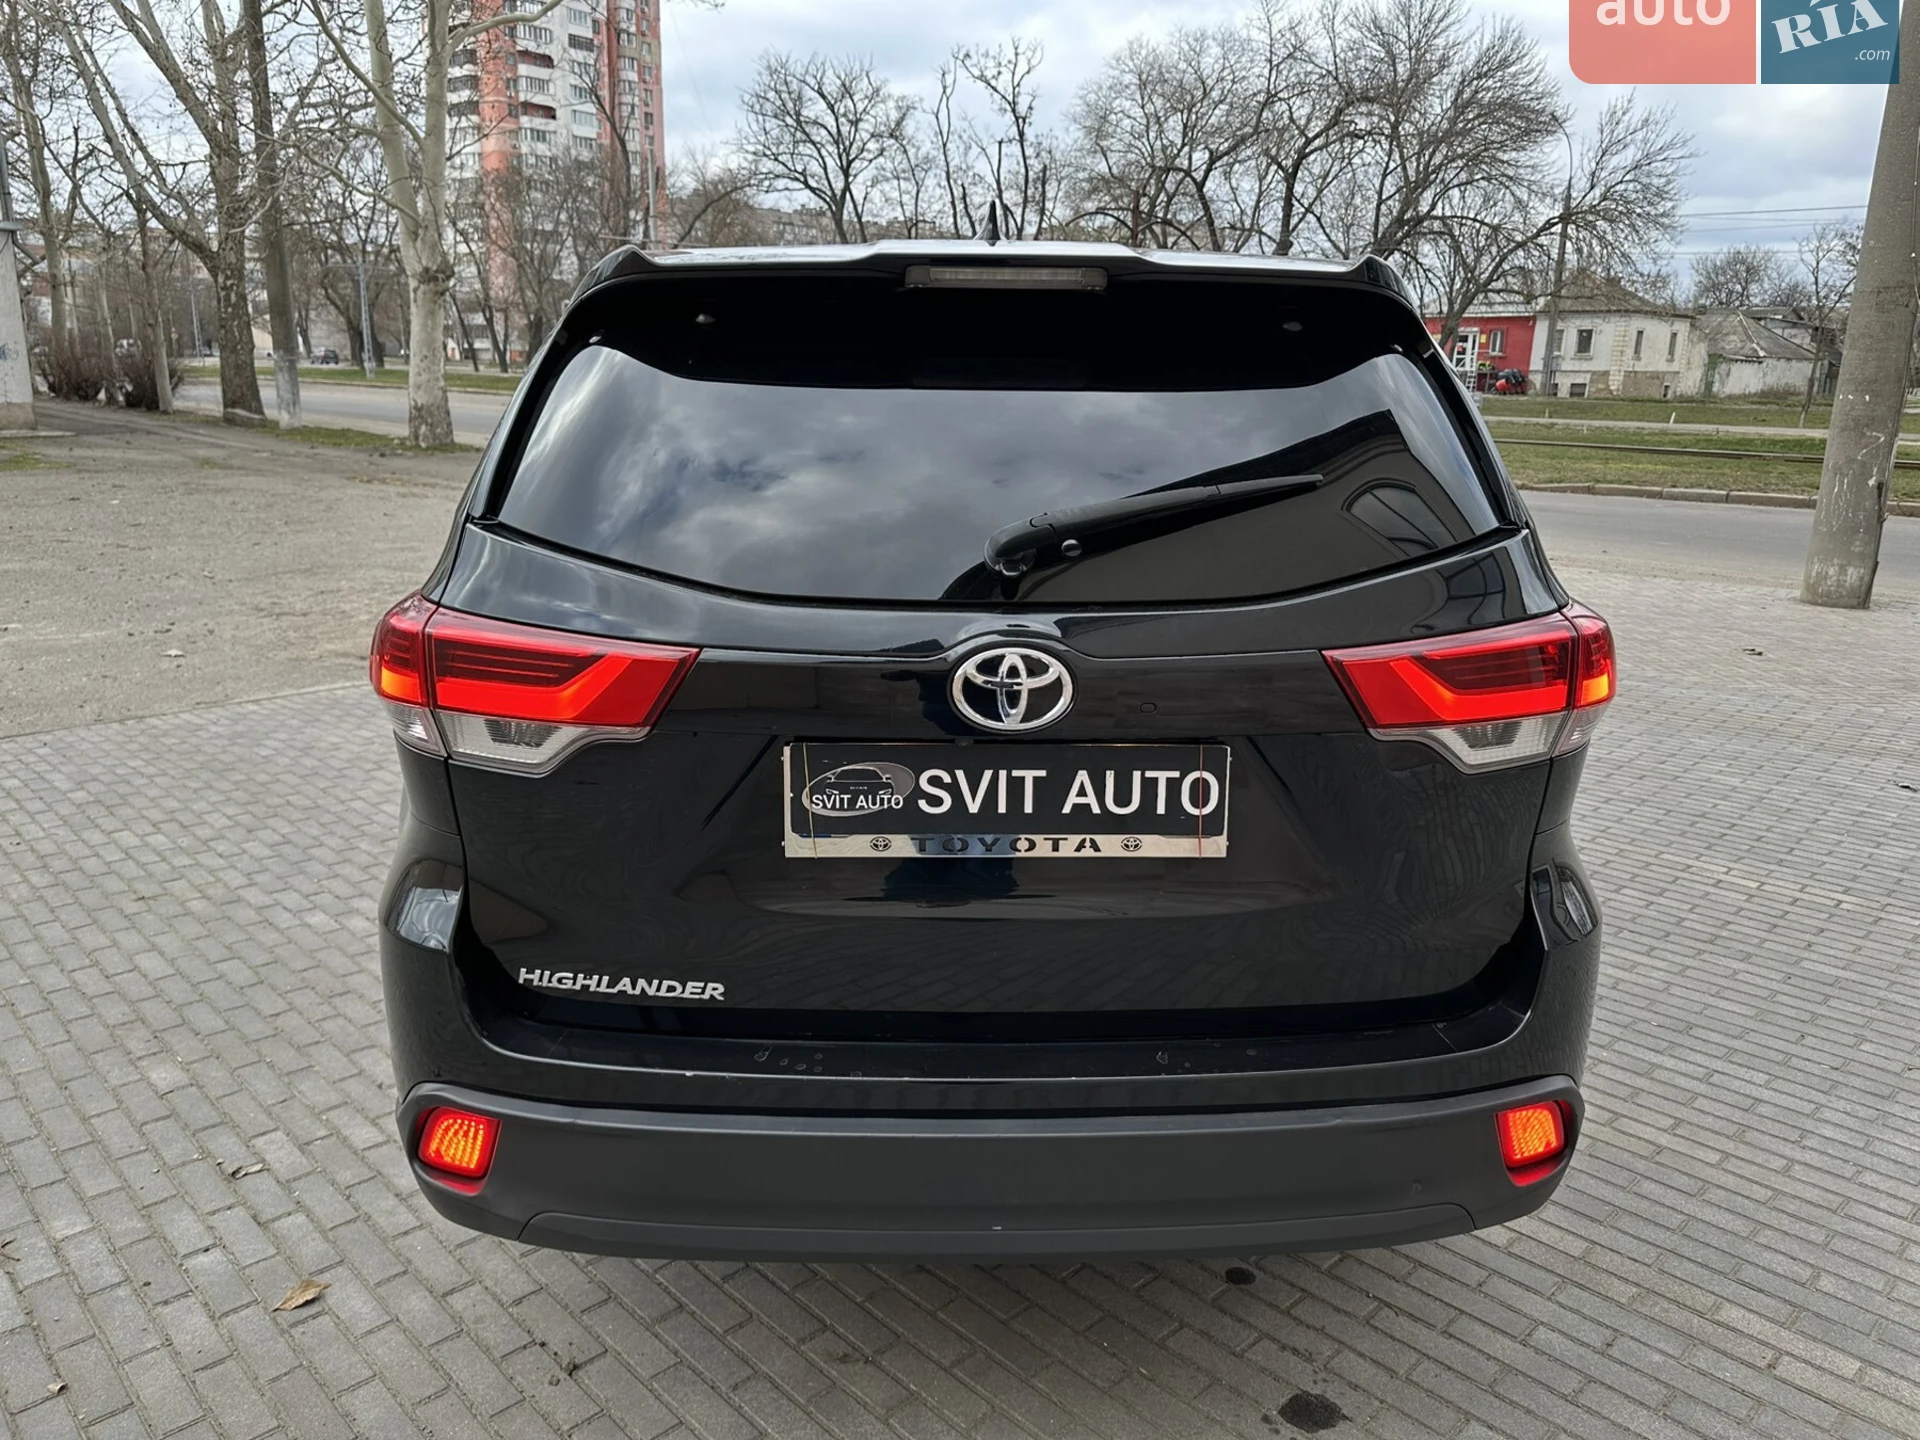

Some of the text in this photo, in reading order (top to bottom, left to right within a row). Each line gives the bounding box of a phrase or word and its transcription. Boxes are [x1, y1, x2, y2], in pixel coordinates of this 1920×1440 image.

[811, 794, 904, 809] SVIT AUTO
[917, 769, 1219, 815] SVIT AUTO
[910, 837, 1102, 853] TOYOTA
[518, 967, 725, 1000] HIGHLANDER
